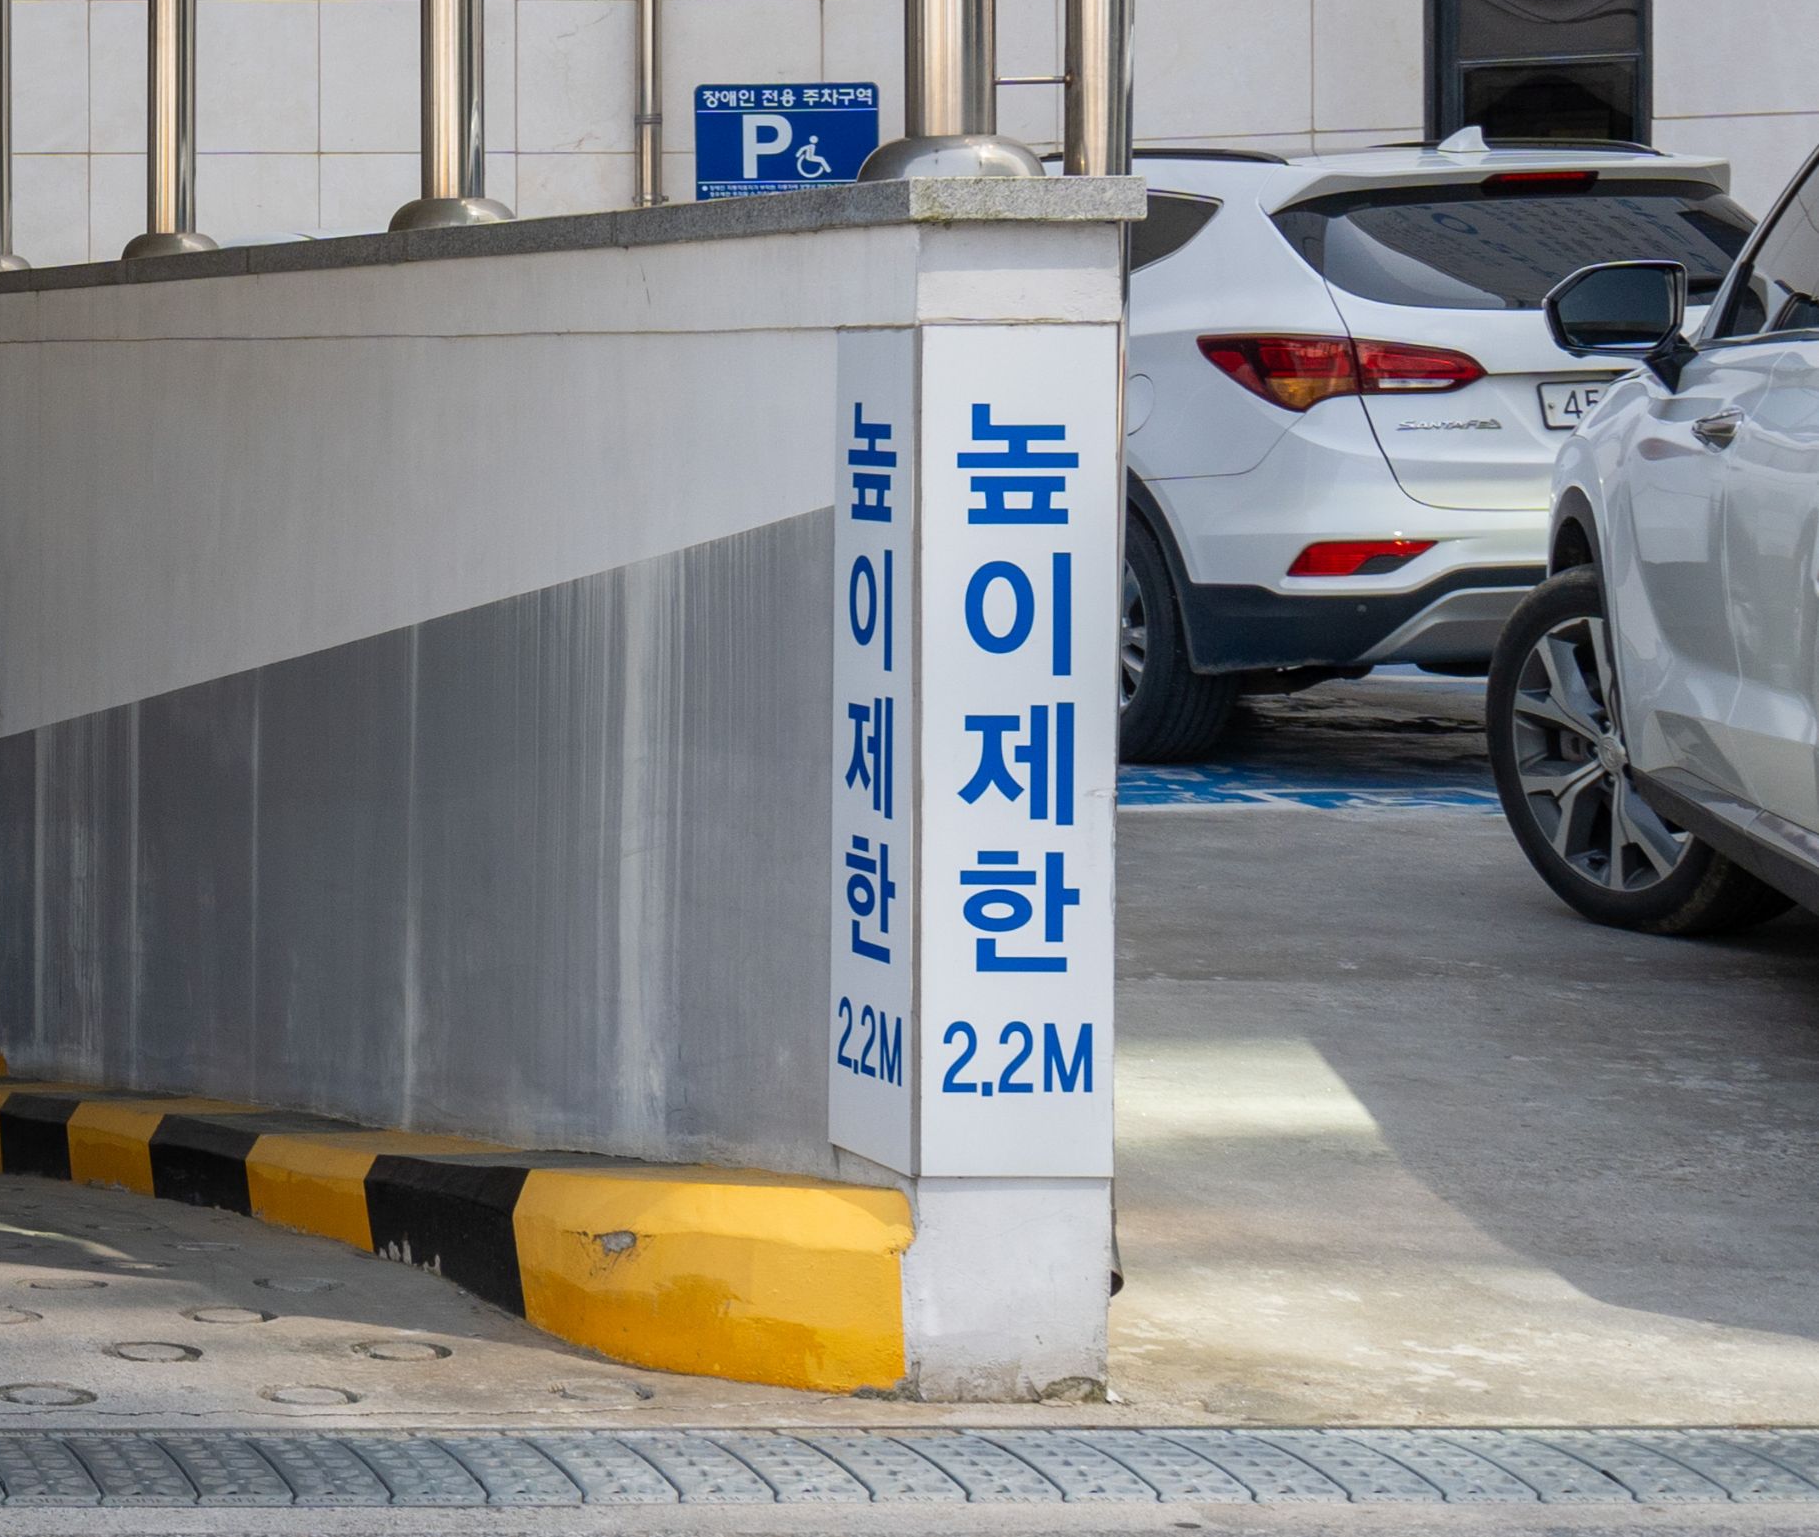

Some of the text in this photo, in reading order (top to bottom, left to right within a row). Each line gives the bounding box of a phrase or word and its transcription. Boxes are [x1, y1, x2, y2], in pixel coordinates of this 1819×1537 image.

[703, 89, 872, 108] 장애인 전용 주차구역
[742, 114, 793, 179] P
[845, 402, 899, 966] 높이제한
[956, 402, 1084, 975] 높이제한
[837, 997, 904, 1089] 2.2M
[941, 1020, 1095, 1099] 2.2M
